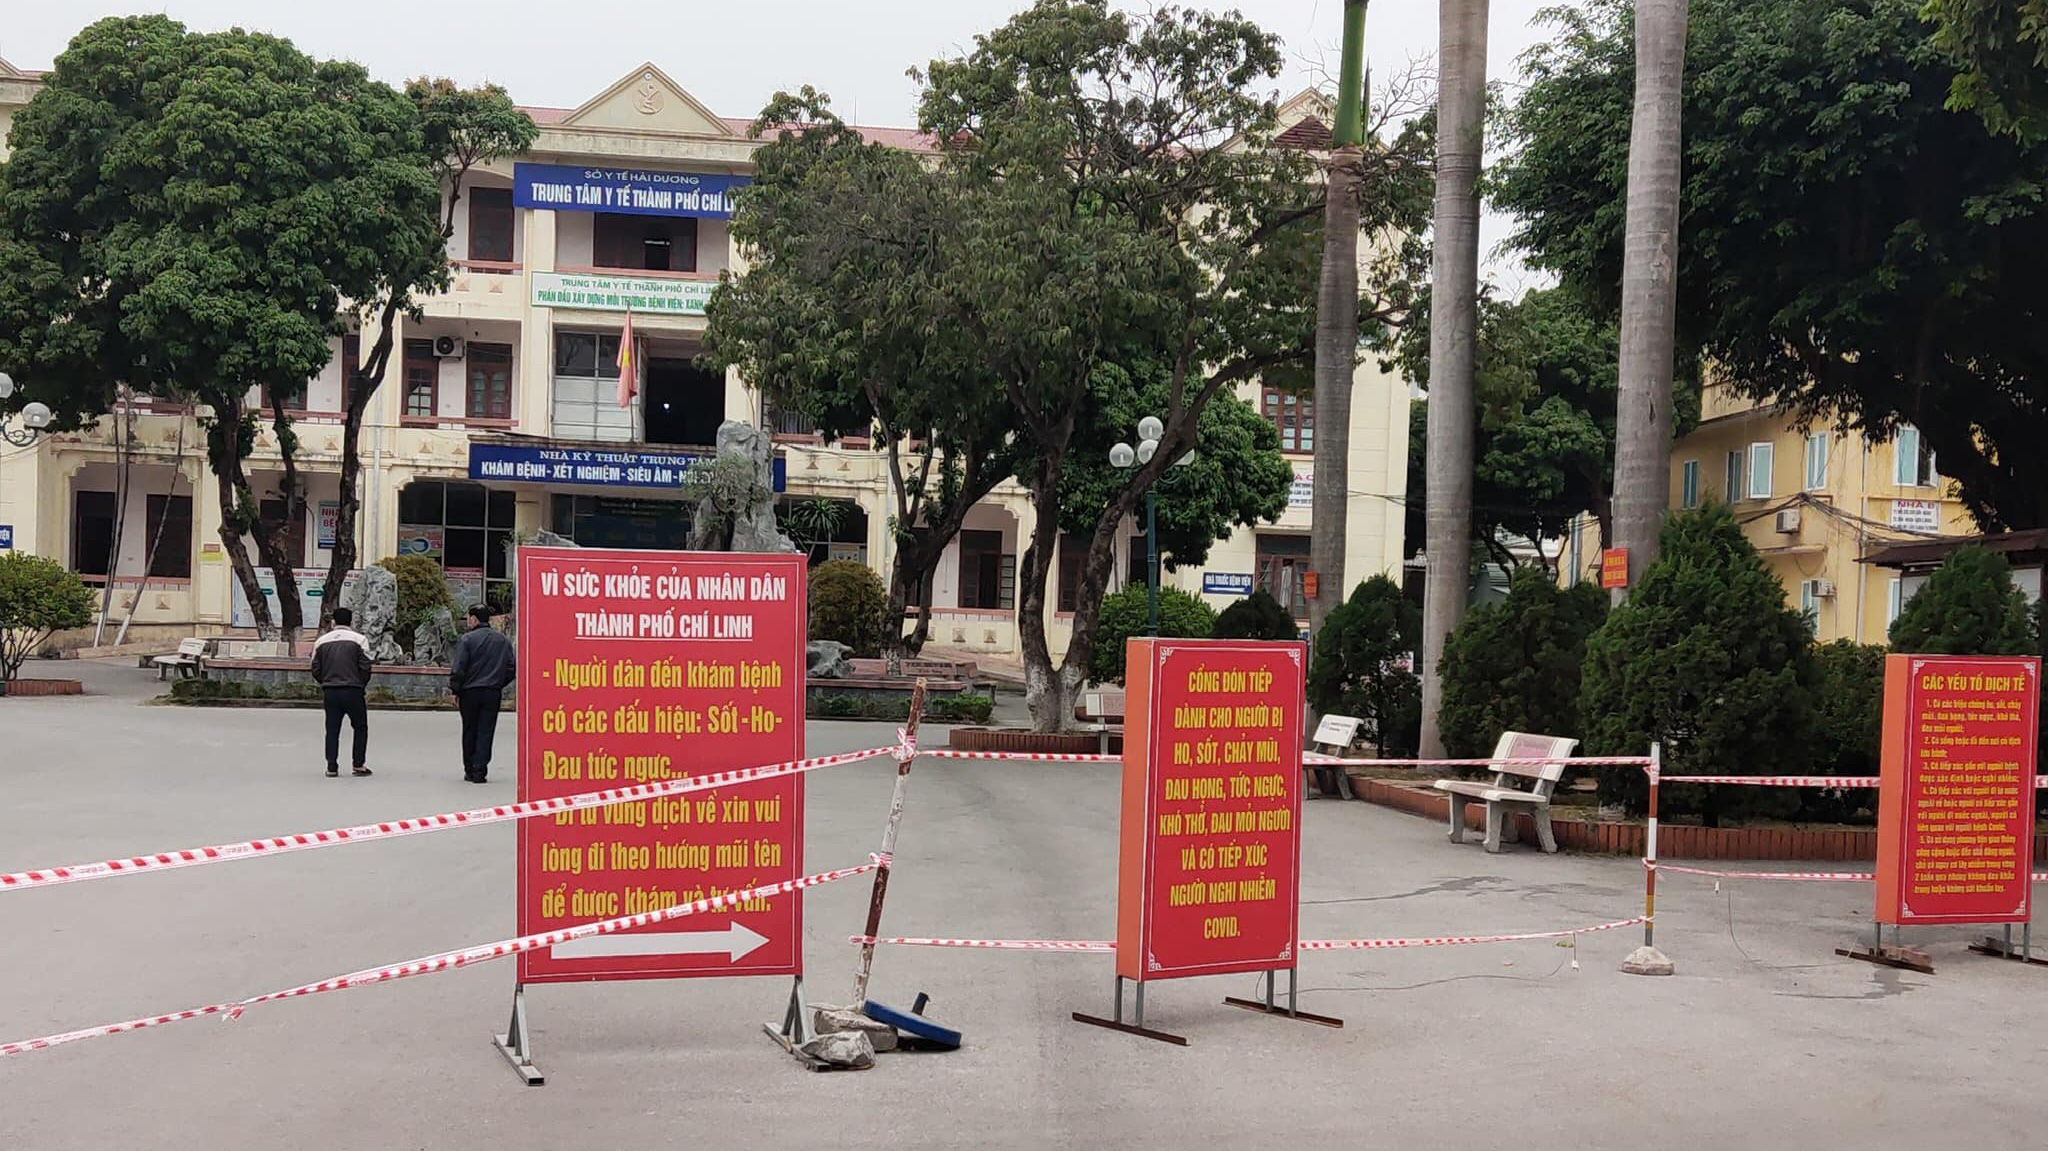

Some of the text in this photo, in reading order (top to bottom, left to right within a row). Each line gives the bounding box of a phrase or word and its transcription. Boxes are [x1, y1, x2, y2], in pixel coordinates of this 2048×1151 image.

[604, 171, 613, 180] Y
[617, 171, 631, 182] TẾ
[653, 174, 700, 185] DƯƠNG
[532, 182, 572, 204] TRUNG
[576, 183, 602, 205] TÂM
[604, 188, 614, 206] Y
[616, 184, 632, 206] TẾ
[632, 186, 672, 208] THÀNH
[674, 187, 700, 210] PHỐ
[702, 190, 723, 212] CHÍ
[561, 279, 589, 288] TRUNG
[591, 280, 611, 289] TÂM
[612, 282, 620, 290] Y
[621, 281, 632, 291] TẾ
[634, 282, 663, 292] THÀNH
[665, 284, 682, 293] PHỐ
[684, 286, 699, 294] CHÍ
[481, 459, 514, 475] KHÁM
[577, 464, 620, 482] NGHIỆM
[627, 466, 652, 483] SIÊU
[654, 465, 672, 484] ÂM
[539, 449, 569, 461] NHÀ
[596, 452, 638, 467] THUẬT
[641, 454, 685, 466] TRUNG
[541, 566, 786, 601] VÌ SỨC KHỎE CỦA NHÂN DÂN
[576, 606, 752, 638] THÀNH PHỐ CHÍ LINH
[555, 654, 607, 691] Người
[613, 660, 645, 688] dân
[650, 656, 682, 688] đến
[688, 660, 734, 688] khám
[740, 660, 782, 694] bệnh
[1188, 663, 1273, 693] CỔNG ĐÓN TIẾP
[1922, 673, 1944, 691] CÁC
[1947, 671, 1967, 691] YẾU
[1970, 672, 1983, 691] TỐ
[1986, 675, 2010, 694] DỊCH
[543, 704, 566, 734] có
[572, 704, 608, 733] các
[614, 699, 649, 734] dấu
[655, 706, 701, 739] hiệu:
[1175, 701, 1283, 734] DÀNH CHO NGƯỜI BỊ
[543, 750, 581, 780] Đau
[588, 748, 617, 780] tức
[1174, 732, 1280, 767] HO, SỐT, CHẢY MŨI,
[1165, 770, 1287, 803] ĐAU HỌNG, TỨC NGỰC,
[652, 796, 690, 830] dịch
[696, 792, 718, 826] về
[722, 796, 748, 823] xin
[754, 795, 780, 822] vui
[1160, 799, 1290, 836] KHÓ THỞ, ĐAU MỎI NGƯỜI
[542, 839, 782, 874] lòng đi theo hướng mũi tên
[1181, 839, 1268, 871] VÀ CÓ TIẾP XÚC
[542, 882, 567, 918] để
[572, 888, 618, 922] được
[624, 882, 677, 914] khám
[1170, 871, 1276, 907] NGƯỜI NGHI NHIỄM
[1204, 916, 1240, 940] COVID.
